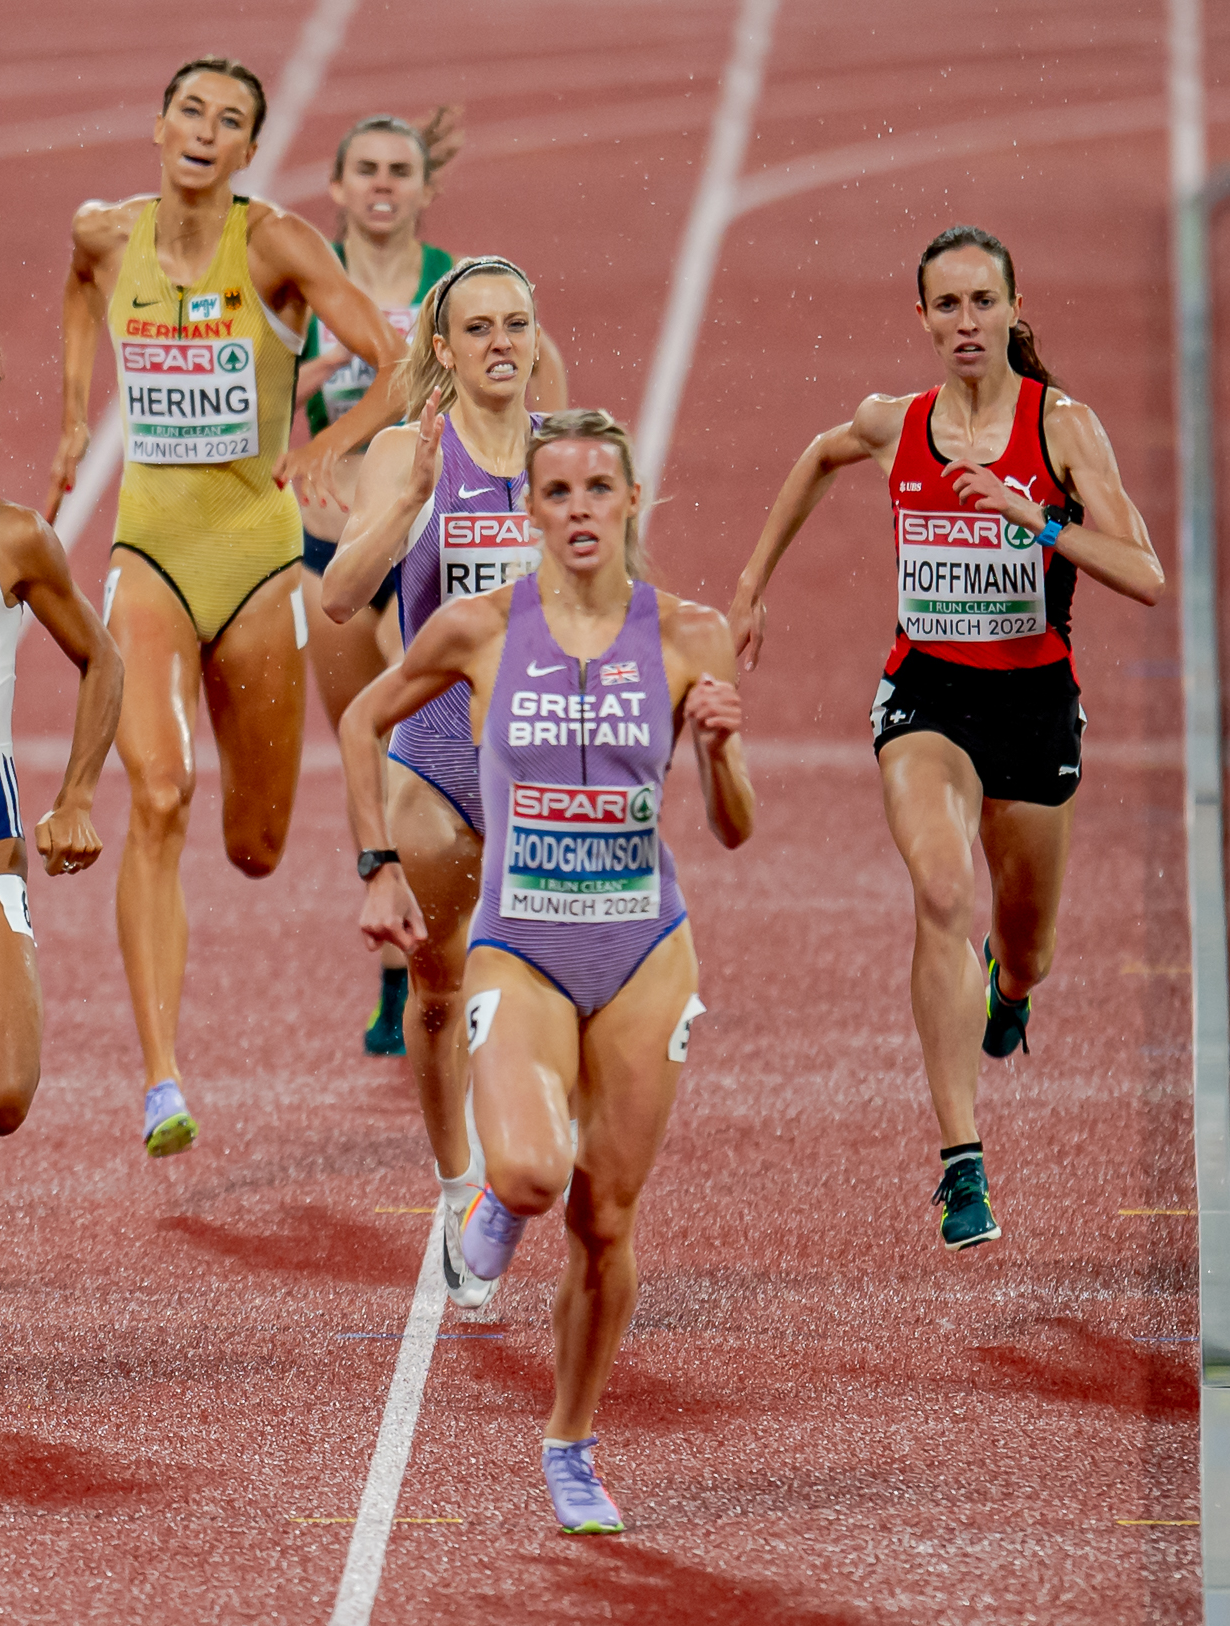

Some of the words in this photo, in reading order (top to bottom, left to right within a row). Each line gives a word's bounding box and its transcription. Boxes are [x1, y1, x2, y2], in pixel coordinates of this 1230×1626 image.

[126, 318, 234, 341] GERMANY
[124, 346, 212, 371] SPAR
[128, 385, 250, 418] HERING
[156, 427, 179, 437] RUN
[133, 440, 198, 459] MUNICH
[204, 438, 249, 458] 2022
[904, 518, 998, 545] SPAR
[903, 559, 1037, 594] HOFFMANN
[936, 602, 962, 613] RUN
[965, 602, 1007, 614] CLEAN
[906, 616, 981, 636] MUNICH
[988, 617, 1037, 636] 2022
[511, 691, 646, 719] GREAT
[509, 721, 650, 747] BRITAIN
[515, 788, 624, 820] SPAR
[509, 831, 654, 873] HODGKINSON
[548, 879, 580, 892] RUN
[511, 893, 596, 916] MUNICH
[604, 896, 650, 916] 2022
